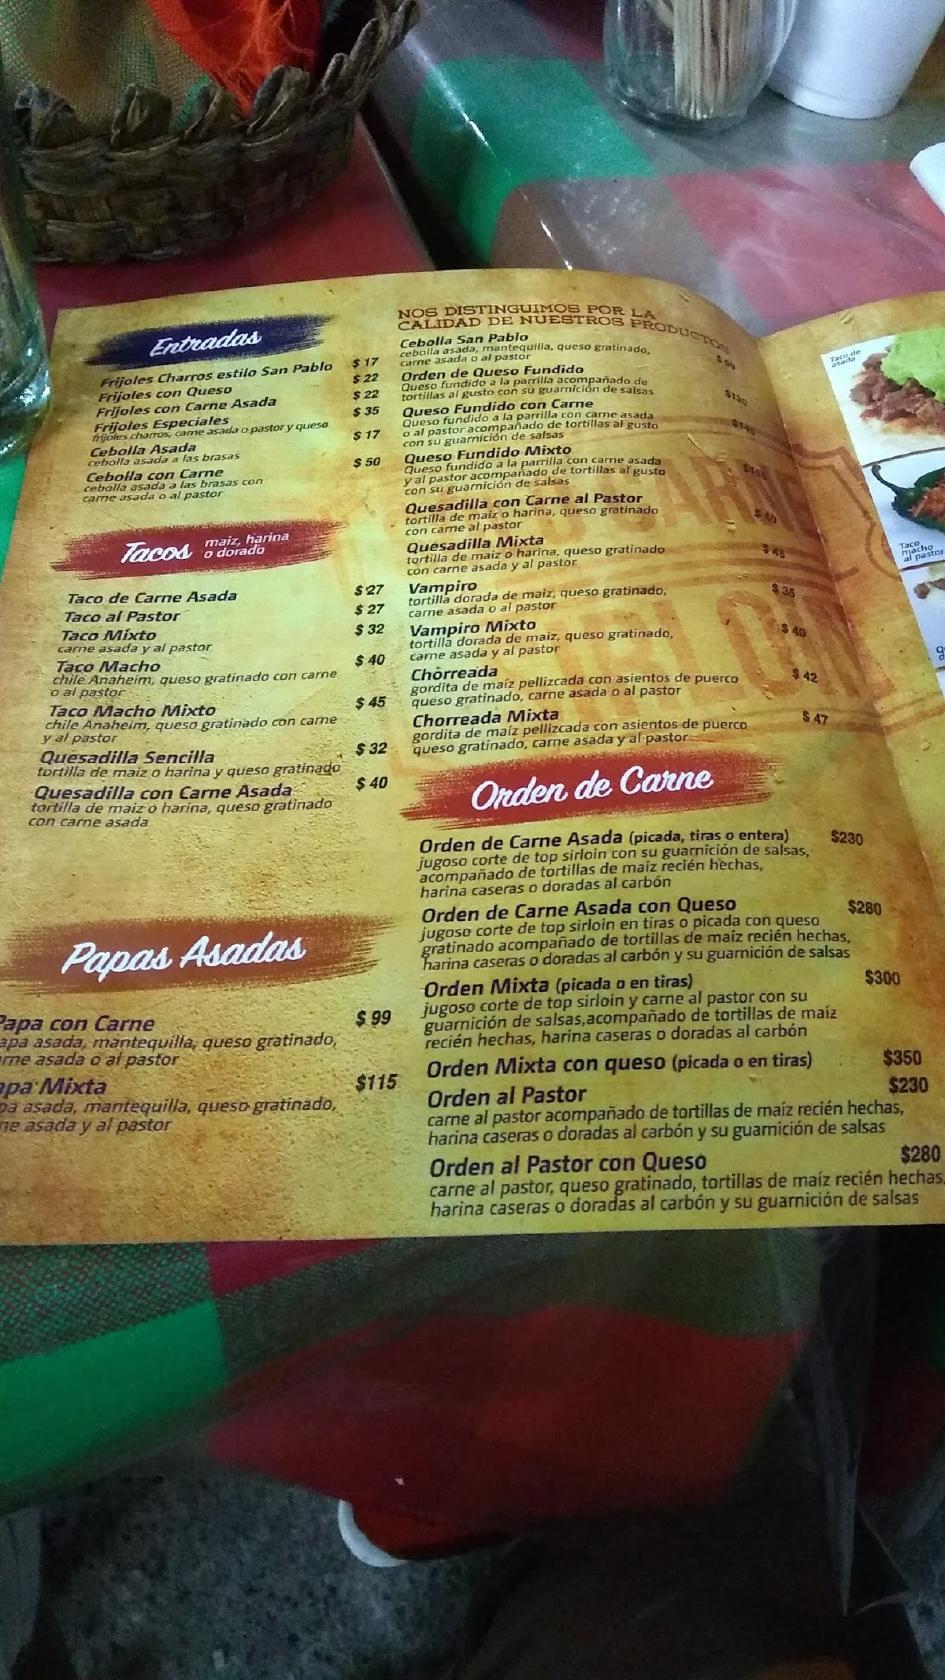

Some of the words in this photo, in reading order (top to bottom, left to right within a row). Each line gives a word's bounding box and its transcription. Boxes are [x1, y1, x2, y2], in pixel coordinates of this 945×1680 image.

[399, 307, 438, 319] NOS
[445, 304, 581, 317] DISTINGUIMOS
[587, 305, 624, 316] POR
[631, 308, 656, 320] LA
[398, 318, 481, 331] CALIDAD
[488, 317, 514, 327] DE
[520, 316, 624, 328] NUESTROS
[150, 329, 262, 357] Entradas
[400, 335, 452, 348] Cebolla
[456, 334, 483, 345] San
[488, 331, 529, 344] Pablo
[100, 375, 153, 390] Frijoles
[157, 372, 213, 385] Charros
[216, 367, 257, 381] estilo
[261, 366, 288, 377] San
[292, 360, 333, 374] Pablo
[401, 369, 445, 382] Orden
[450, 368, 468, 379] de
[472, 367, 519, 379] Queso
[524, 363, 584, 376] Fundido
[96, 404, 150, 419] Frijoles
[153, 404, 180, 414] con
[185, 401, 227, 412] Carne
[230, 396, 277, 409] Asada
[403, 406, 449, 418] Queso
[454, 400, 515, 414] Fundido
[520, 401, 546, 411] con
[551, 398, 593, 409] Carne
[94, 420, 148, 435] Frijoles
[152, 415, 229, 431] Especiales
[90, 444, 146, 458] Cebolla
[149, 442, 196, 455] Asada
[88, 456, 130, 467] cebolla
[133, 454, 168, 465] asada
[182, 453, 199, 463] las
[201, 452, 240, 462] brasas
[87, 470, 142, 483] Cebolla
[147, 471, 174, 480] con
[179, 468, 224, 479] Carne
[406, 498, 488, 515] Quesadilla
[493, 499, 520, 509] con
[525, 496, 570, 507] Carne
[574, 493, 588, 505] al
[594, 493, 643, 504] Pastor
[246, 532, 289, 544] harina
[407, 537, 491, 554] Quesadilla
[495, 535, 544, 548] Mixta
[121, 541, 192, 564] Tacos
[217, 545, 265, 558] dorado
[902, 545, 934, 555] macho
[915, 549, 944, 560] pastor
[68, 594, 103, 605] Taco
[108, 592, 129, 604] de
[135, 592, 182, 604] Carne
[186, 590, 237, 603] Asada
[65, 612, 101, 623] Taco
[105, 610, 121, 623] al
[126, 610, 180, 622] Pastor
[410, 624, 480, 638] Vampiro
[485, 620, 536, 633] Mixto
[56, 661, 94, 673] Taco
[98, 660, 160, 673] Macho
[412, 665, 498, 682] Chorreada
[50, 706, 88, 718] Taco
[92, 704, 156, 717] Macho
[160, 705, 216, 717] Mixto
[413, 711, 501, 728] Chorreada
[507, 709, 559, 723] Mixta
[40, 750, 138, 765] Quesadilla
[143, 750, 215, 764] Sencilla
[35, 785, 135, 802] Quesadilla
[140, 788, 173, 799] con
[179, 785, 231, 798] Carne
[235, 782, 292, 797] Asada
[472, 776, 569, 811] Orden
[575, 771, 612, 797] de
[621, 766, 714, 796] Carne
[420, 837, 475, 854] Orden
[481, 835, 503, 850] de
[509, 835, 561, 849] Carne
[566, 830, 622, 847] Asada
[629, 829, 684, 848] (picada,
[689, 829, 721, 843] tiras
[725, 831, 734, 842] o
[738, 827, 789, 844] entera)
[831, 829, 863, 846] $230
[418, 856, 467, 871] jugoso
[472, 854, 507, 867] corte
[512, 852, 530, 865] de
[534, 851, 558, 866] top
[562, 847, 607, 862] sirloin
[611, 849, 636, 859] con
[641, 848, 657, 858] su
[661, 843, 738, 861] guarnición
[742, 843, 760, 856] de
[764, 843, 810, 857] salsas,
[422, 906, 479, 924] Orden
[485, 904, 508, 921] de
[515, 904, 568, 919] Carne
[574, 899, 631, 917] Asada
[638, 902, 670, 914] con
[677, 898, 736, 914] Queso
[848, 899, 882, 916] $280
[61, 942, 172, 982] Papas
[179, 932, 306, 968] Asadas
[865, 969, 900, 986] $300
[49, 1019, 88, 1032] con
[94, 1016, 155, 1031] Carne
[427, 1059, 488, 1078] Orden
[494, 1058, 556, 1076] Mixta
[563, 1060, 598, 1073] con
[604, 1057, 666, 1076] queso
[672, 1052, 728, 1074] (picada
[733, 1056, 743, 1069] o
[748, 1056, 767, 1069] en
[772, 1051, 813, 1072] tiras)
[883, 1050, 922, 1066] $350
[39, 1079, 106, 1095] Mixta
[356, 1073, 397, 1091] $115
[888, 1077, 928, 1095] $230
[428, 1089, 490, 1108] Orden
[496, 1087, 514, 1105] al
[522, 1087, 587, 1105] Pastor
[428, 1130, 478, 1146] harina
[483, 1131, 539, 1144] caseras
[543, 1131, 553, 1142] o
[557, 1125, 619, 1142] doradas
[623, 1124, 636, 1140] al
[641, 1122, 693, 1139] carbón
[698, 1126, 707, 1141] y
[710, 1126, 728, 1137] su
[732, 1120, 813, 1140] guarnición
[817, 1119, 837, 1135] de
[841, 1119, 885, 1135] salsas
[901, 1145, 941, 1164] $280
[431, 1158, 494, 1177] Orden
[501, 1156, 519, 1175] al
[527, 1156, 592, 1175] Pastor
[598, 1159, 635, 1173] con
[642, 1154, 707, 1173] Queso
